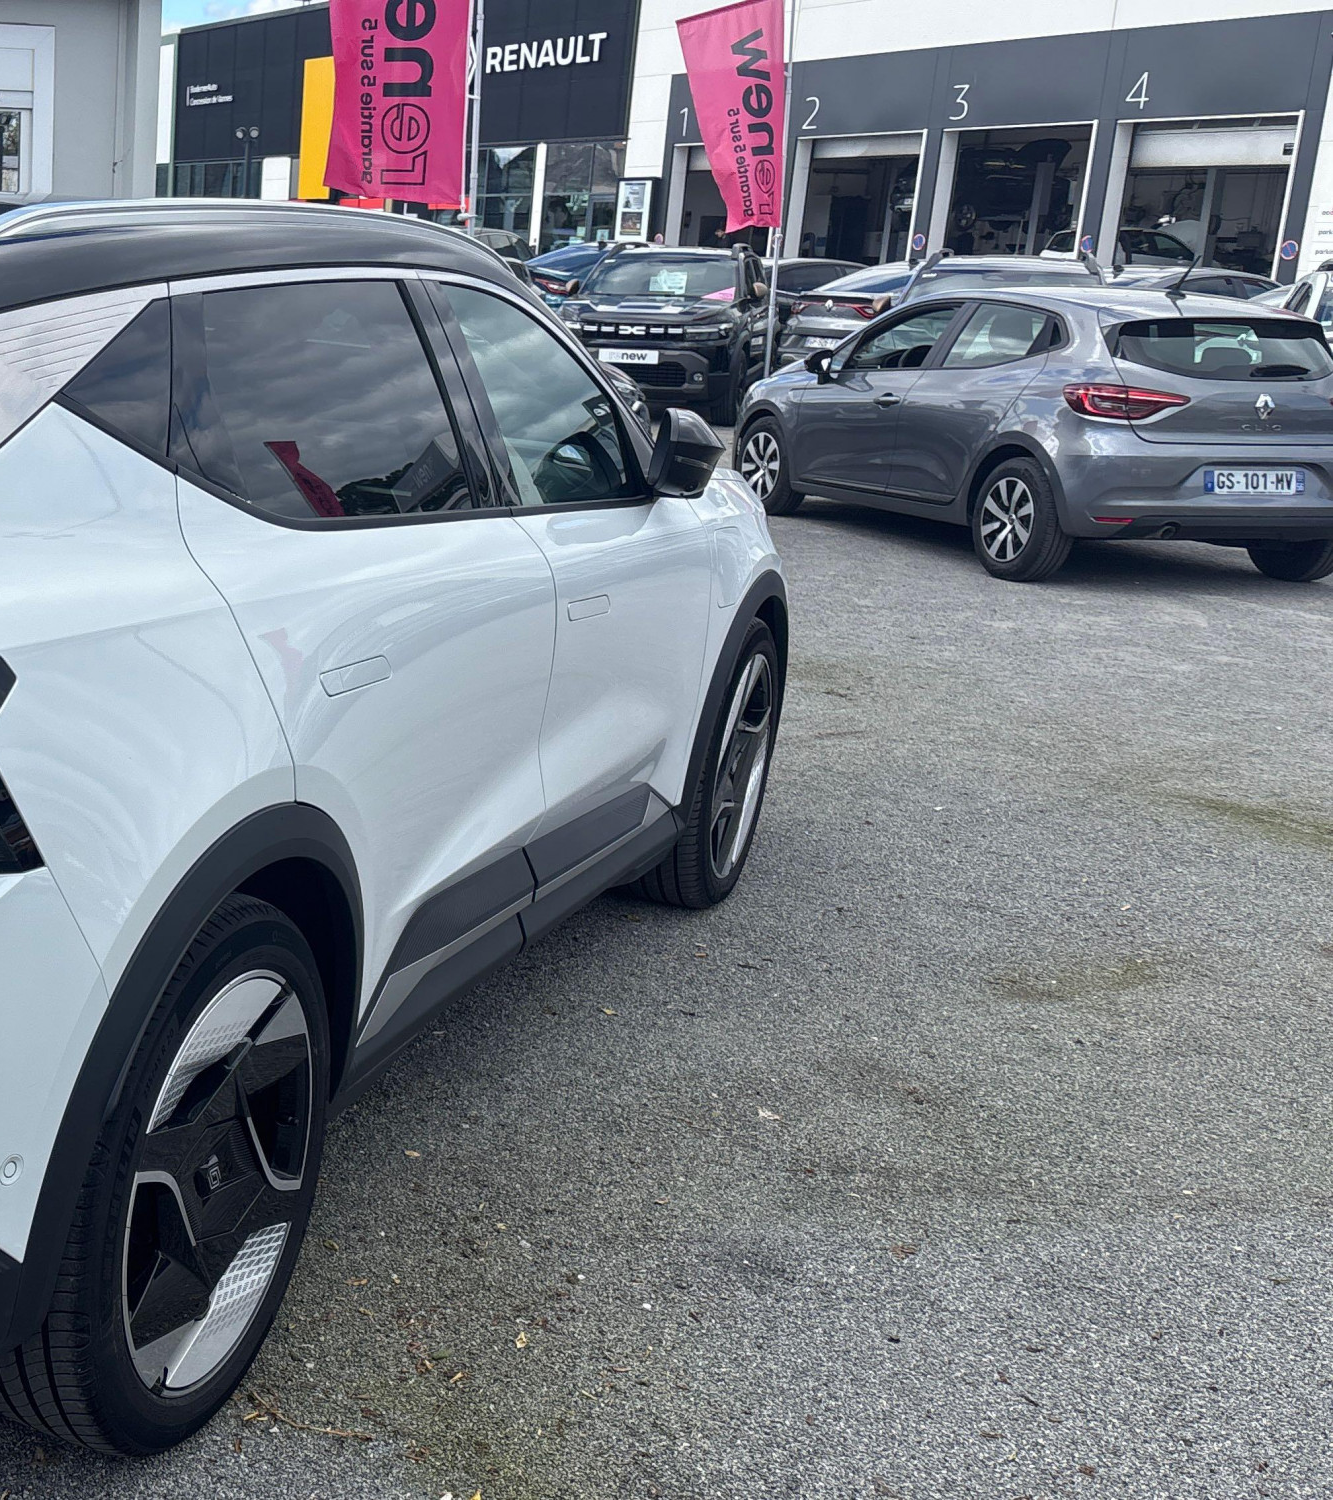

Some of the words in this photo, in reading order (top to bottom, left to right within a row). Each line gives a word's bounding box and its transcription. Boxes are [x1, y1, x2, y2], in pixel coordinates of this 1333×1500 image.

[485, 31, 607, 74] RENAULT
[949, 84, 970, 121] 3
[1125, 71, 1150, 110] 4
[679, 107, 688, 137] 1
[801, 96, 820, 130] 2
[1217, 472, 1294, 490] GS-101-MV
